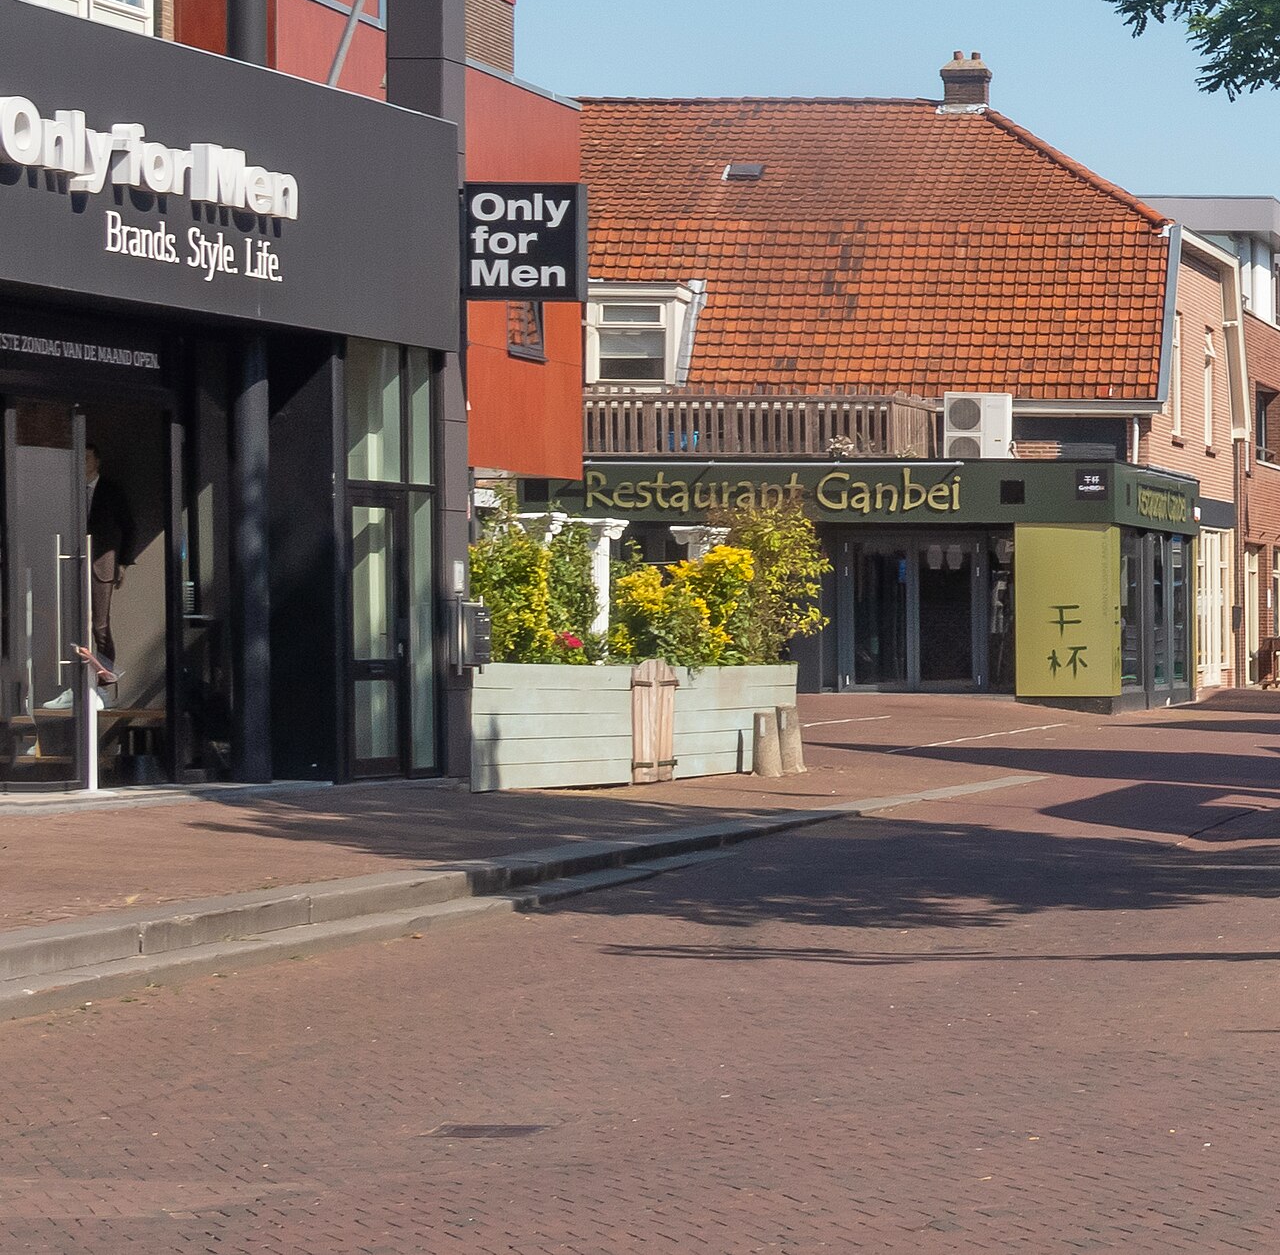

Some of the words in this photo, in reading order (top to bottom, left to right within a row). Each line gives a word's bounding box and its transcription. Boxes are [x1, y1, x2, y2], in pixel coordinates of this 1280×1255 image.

[0, 96, 113, 194] Only
[111, 123, 192, 195] for
[190, 142, 299, 220] Men
[471, 192, 571, 228] Only
[105, 210, 180, 264] Brands.
[187, 226, 238, 282] Style.
[245, 237, 283, 282] Life.
[470, 225, 539, 255] for
[470, 259, 566, 288] Men
[0, 333, 20, 351] STE
[21, 336, 61, 356] ZONDAG
[62, 341, 83, 359] VAN
[84, 344, 97, 361] DE
[98, 346, 132, 365] MAAND
[585, 471, 806, 513] Restaurant
[816, 467, 961, 514] Ganbei
